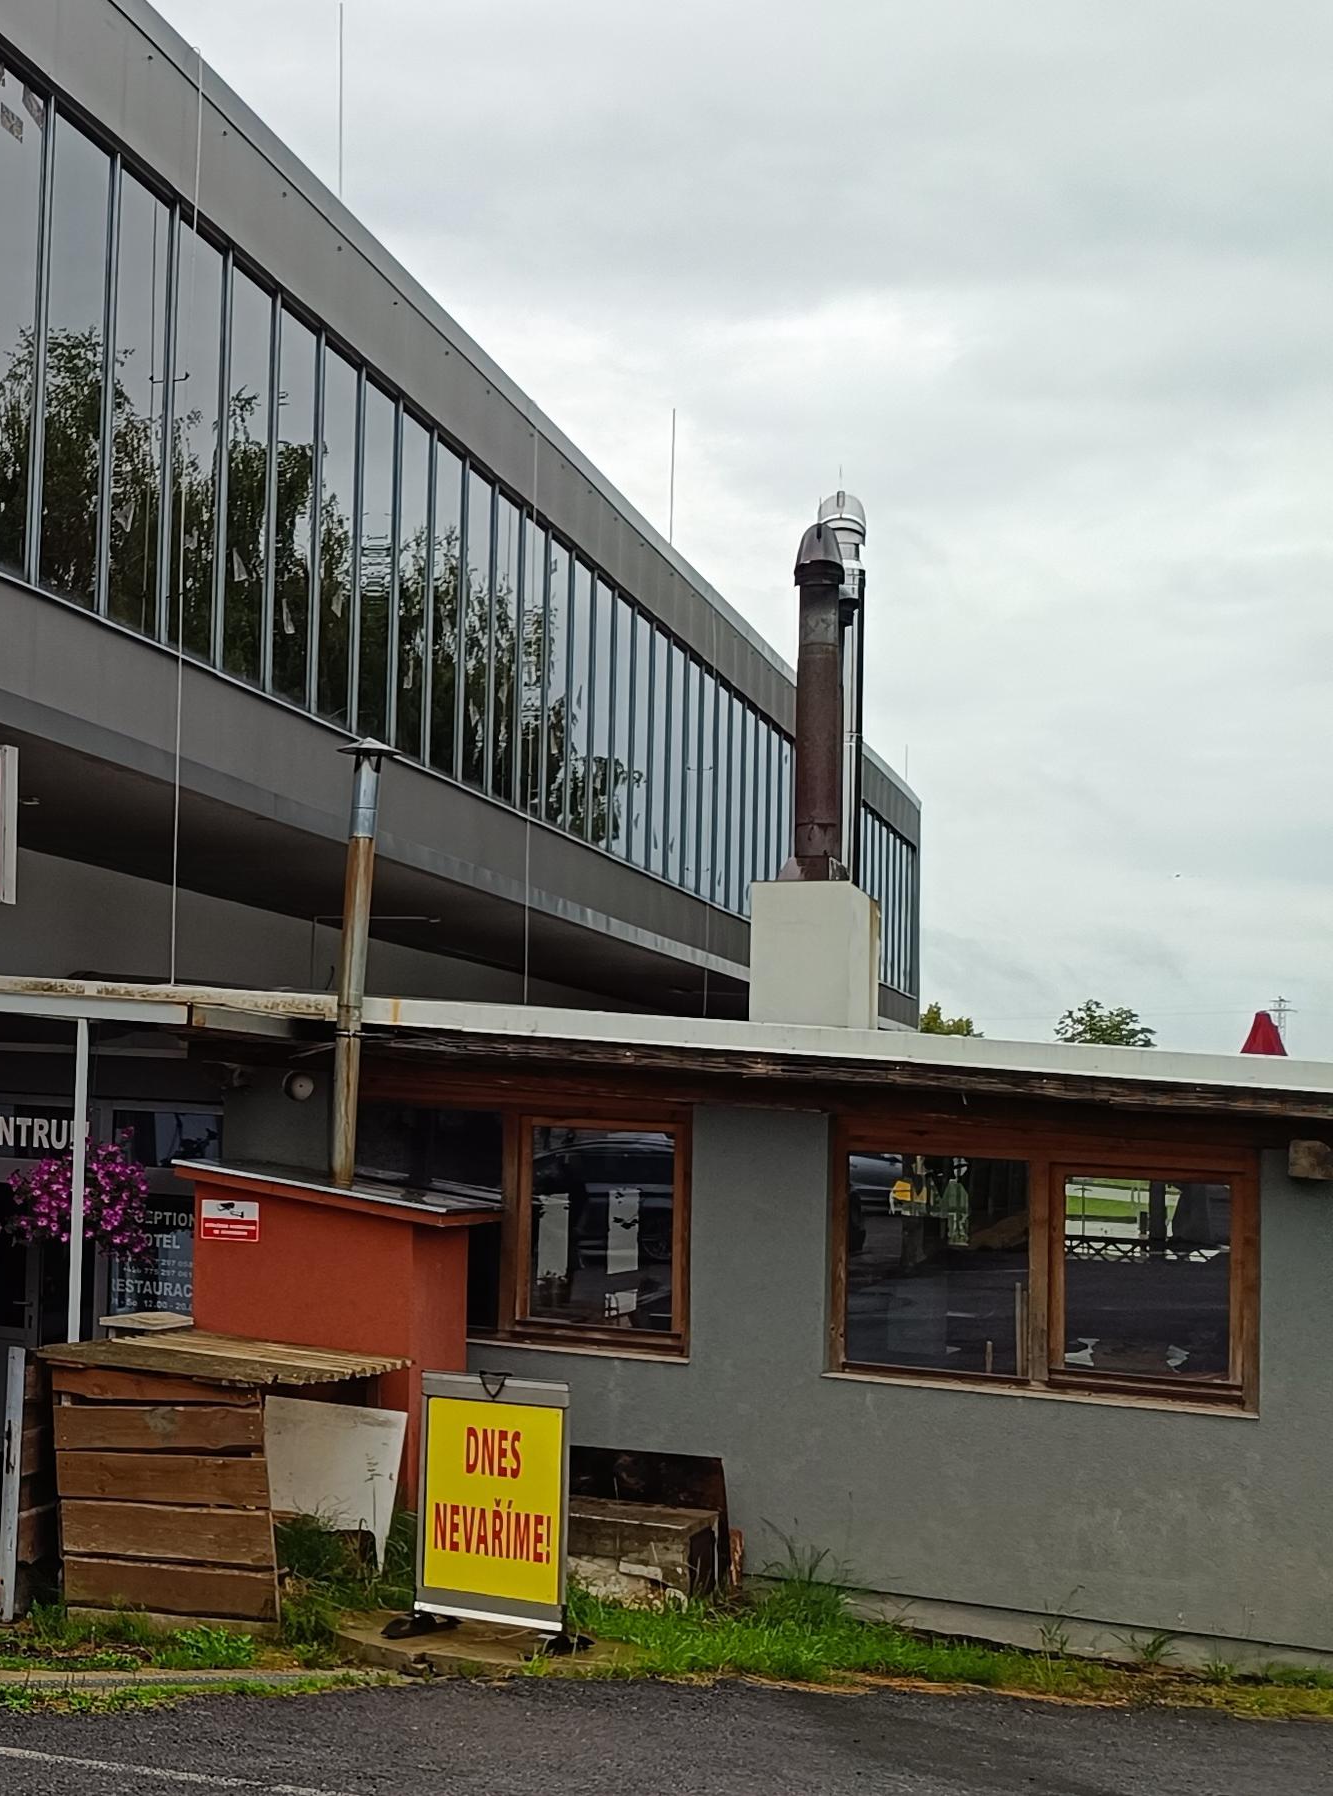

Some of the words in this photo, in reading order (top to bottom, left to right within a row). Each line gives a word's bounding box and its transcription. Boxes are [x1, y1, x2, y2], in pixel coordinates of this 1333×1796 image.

[144, 1233, 180, 1249] OTEL
[111, 1278, 193, 1298] ESTAURAC
[465, 1426, 521, 1479] DNES
[434, 1498, 551, 1565] NEVAŘÍME!
